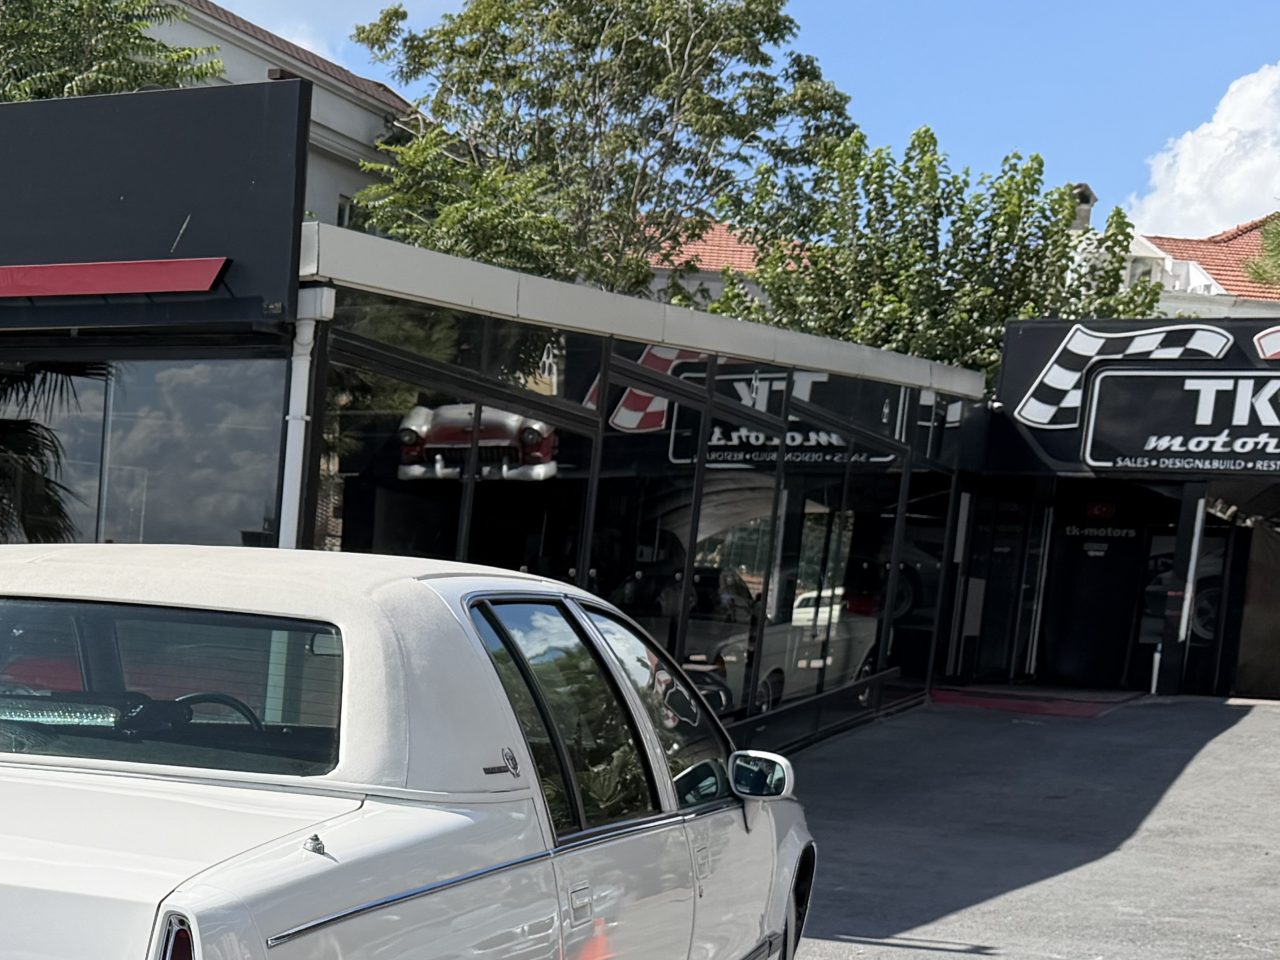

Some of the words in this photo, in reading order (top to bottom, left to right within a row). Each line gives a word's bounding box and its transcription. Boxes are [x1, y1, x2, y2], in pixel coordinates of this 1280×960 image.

[1183, 379, 1280, 426] TK
[1115, 457, 1150, 468] SALES
[1159, 457, 1245, 470] DESIGN&BUILD
[1065, 525, 1137, 537] tk-motors
